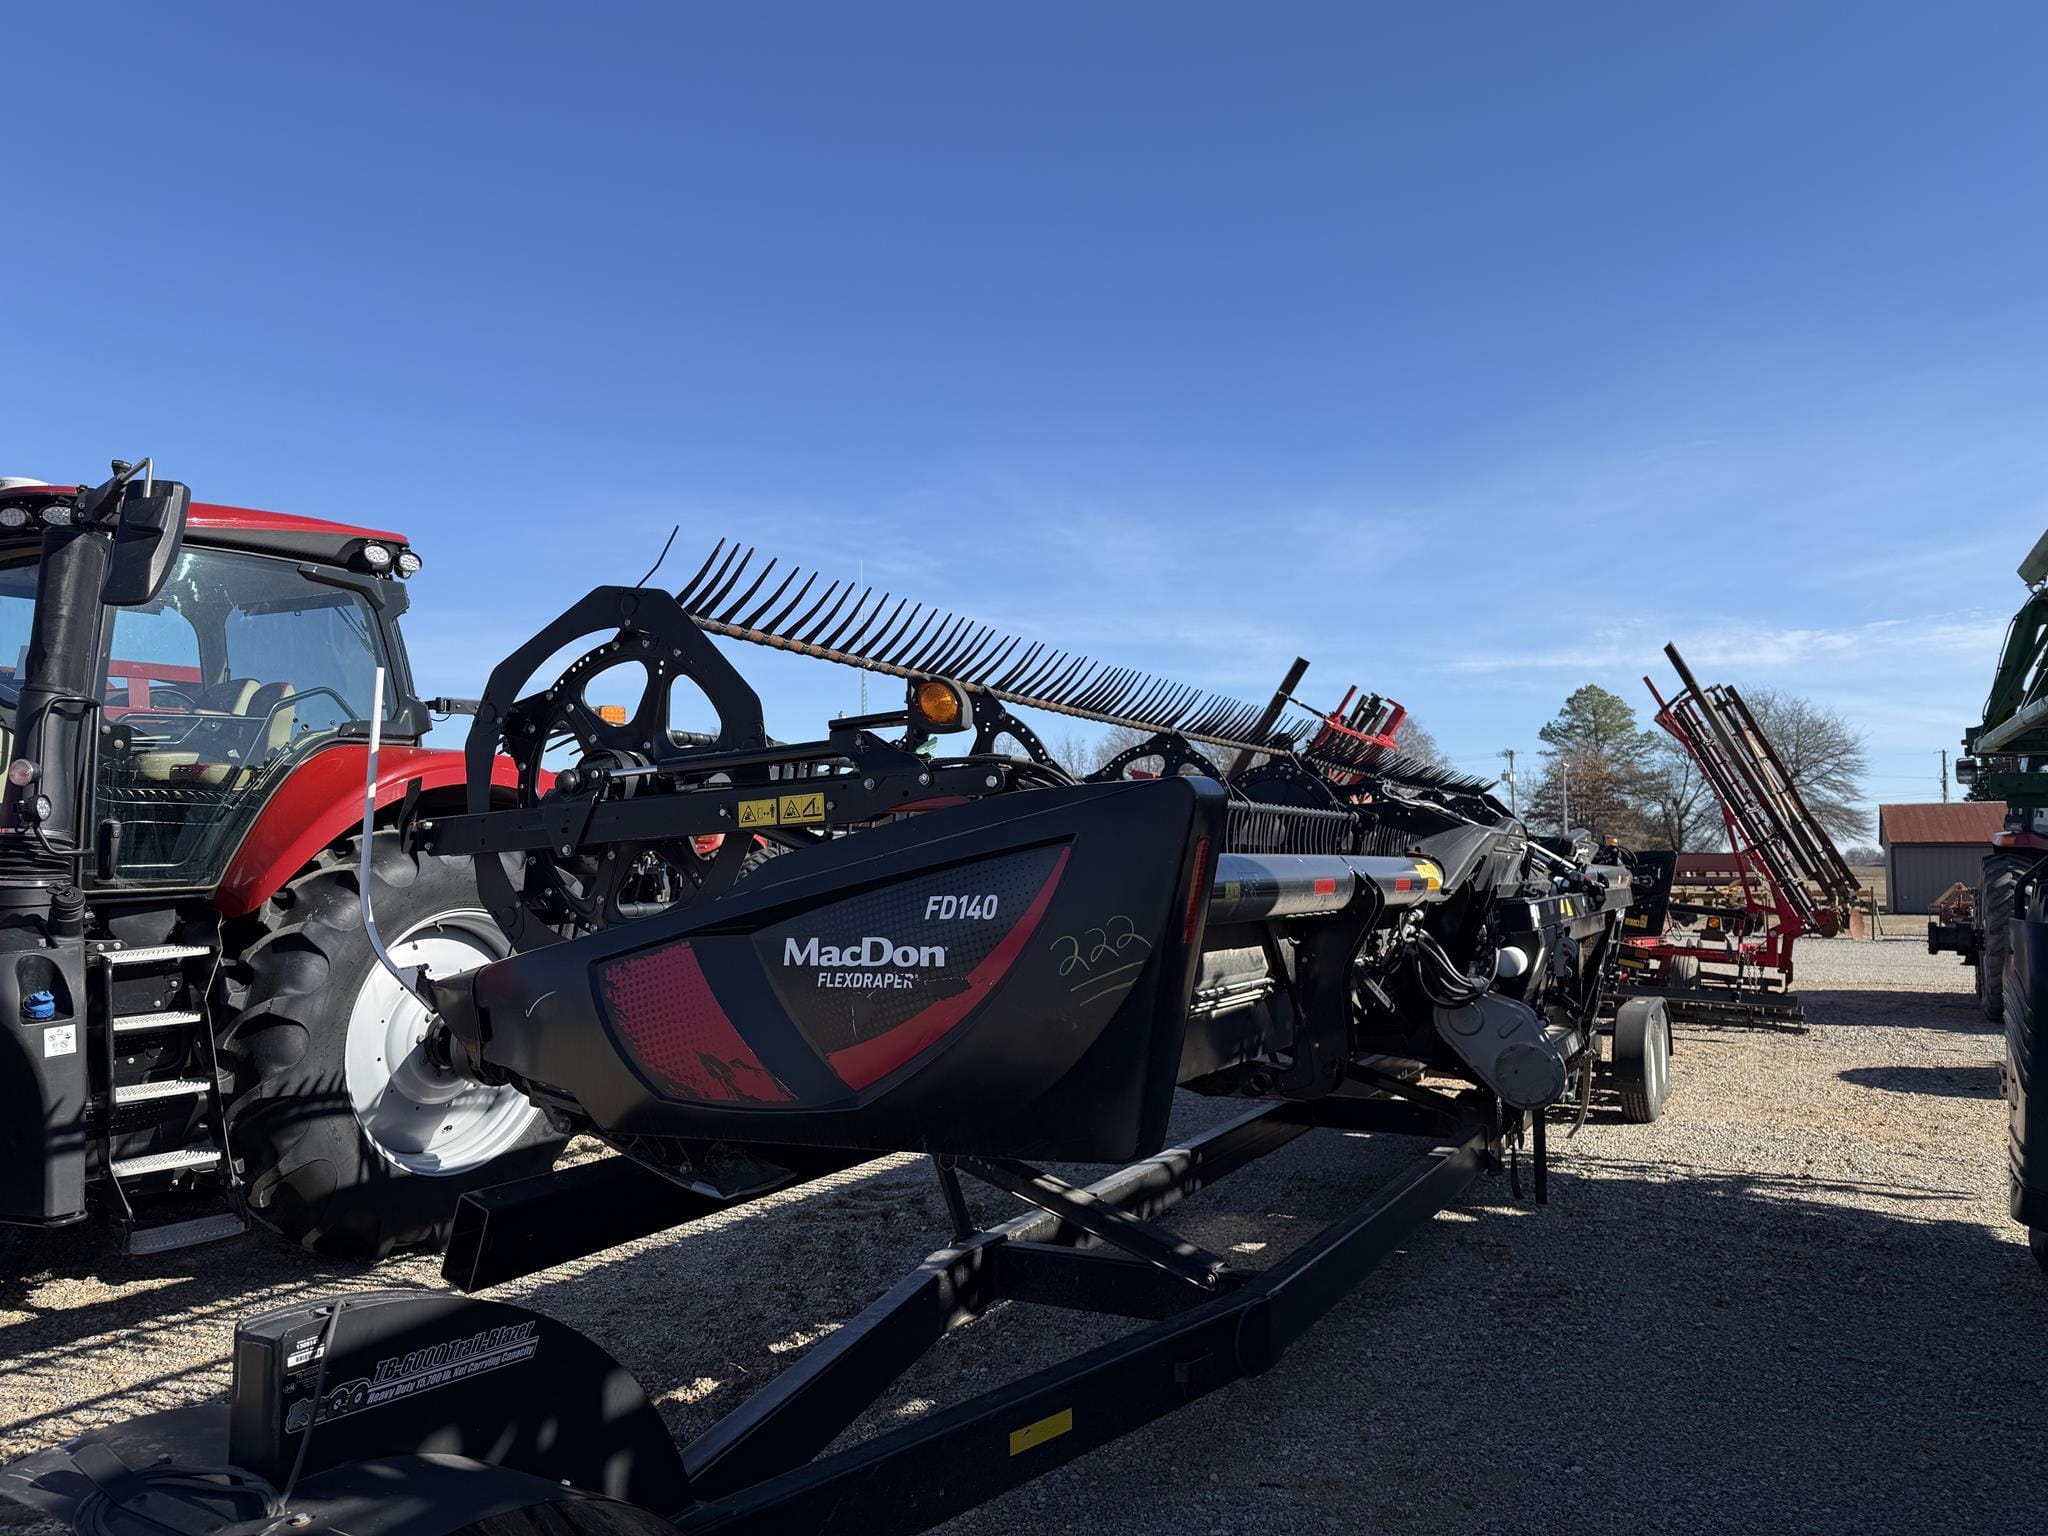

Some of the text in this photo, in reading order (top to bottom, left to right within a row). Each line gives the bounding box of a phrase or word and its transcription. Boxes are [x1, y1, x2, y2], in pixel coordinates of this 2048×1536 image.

[925, 894, 998, 920] FD140
[783, 936, 946, 967] MacDon
[1050, 914, 1152, 977] 222
[818, 972, 915, 989] FLEXDRAPER
[373, 1320, 536, 1384] TB-6000 Trail-Blazer
[367, 1388, 395, 1404] Heavy
[395, 1381, 415, 1396] Duty
